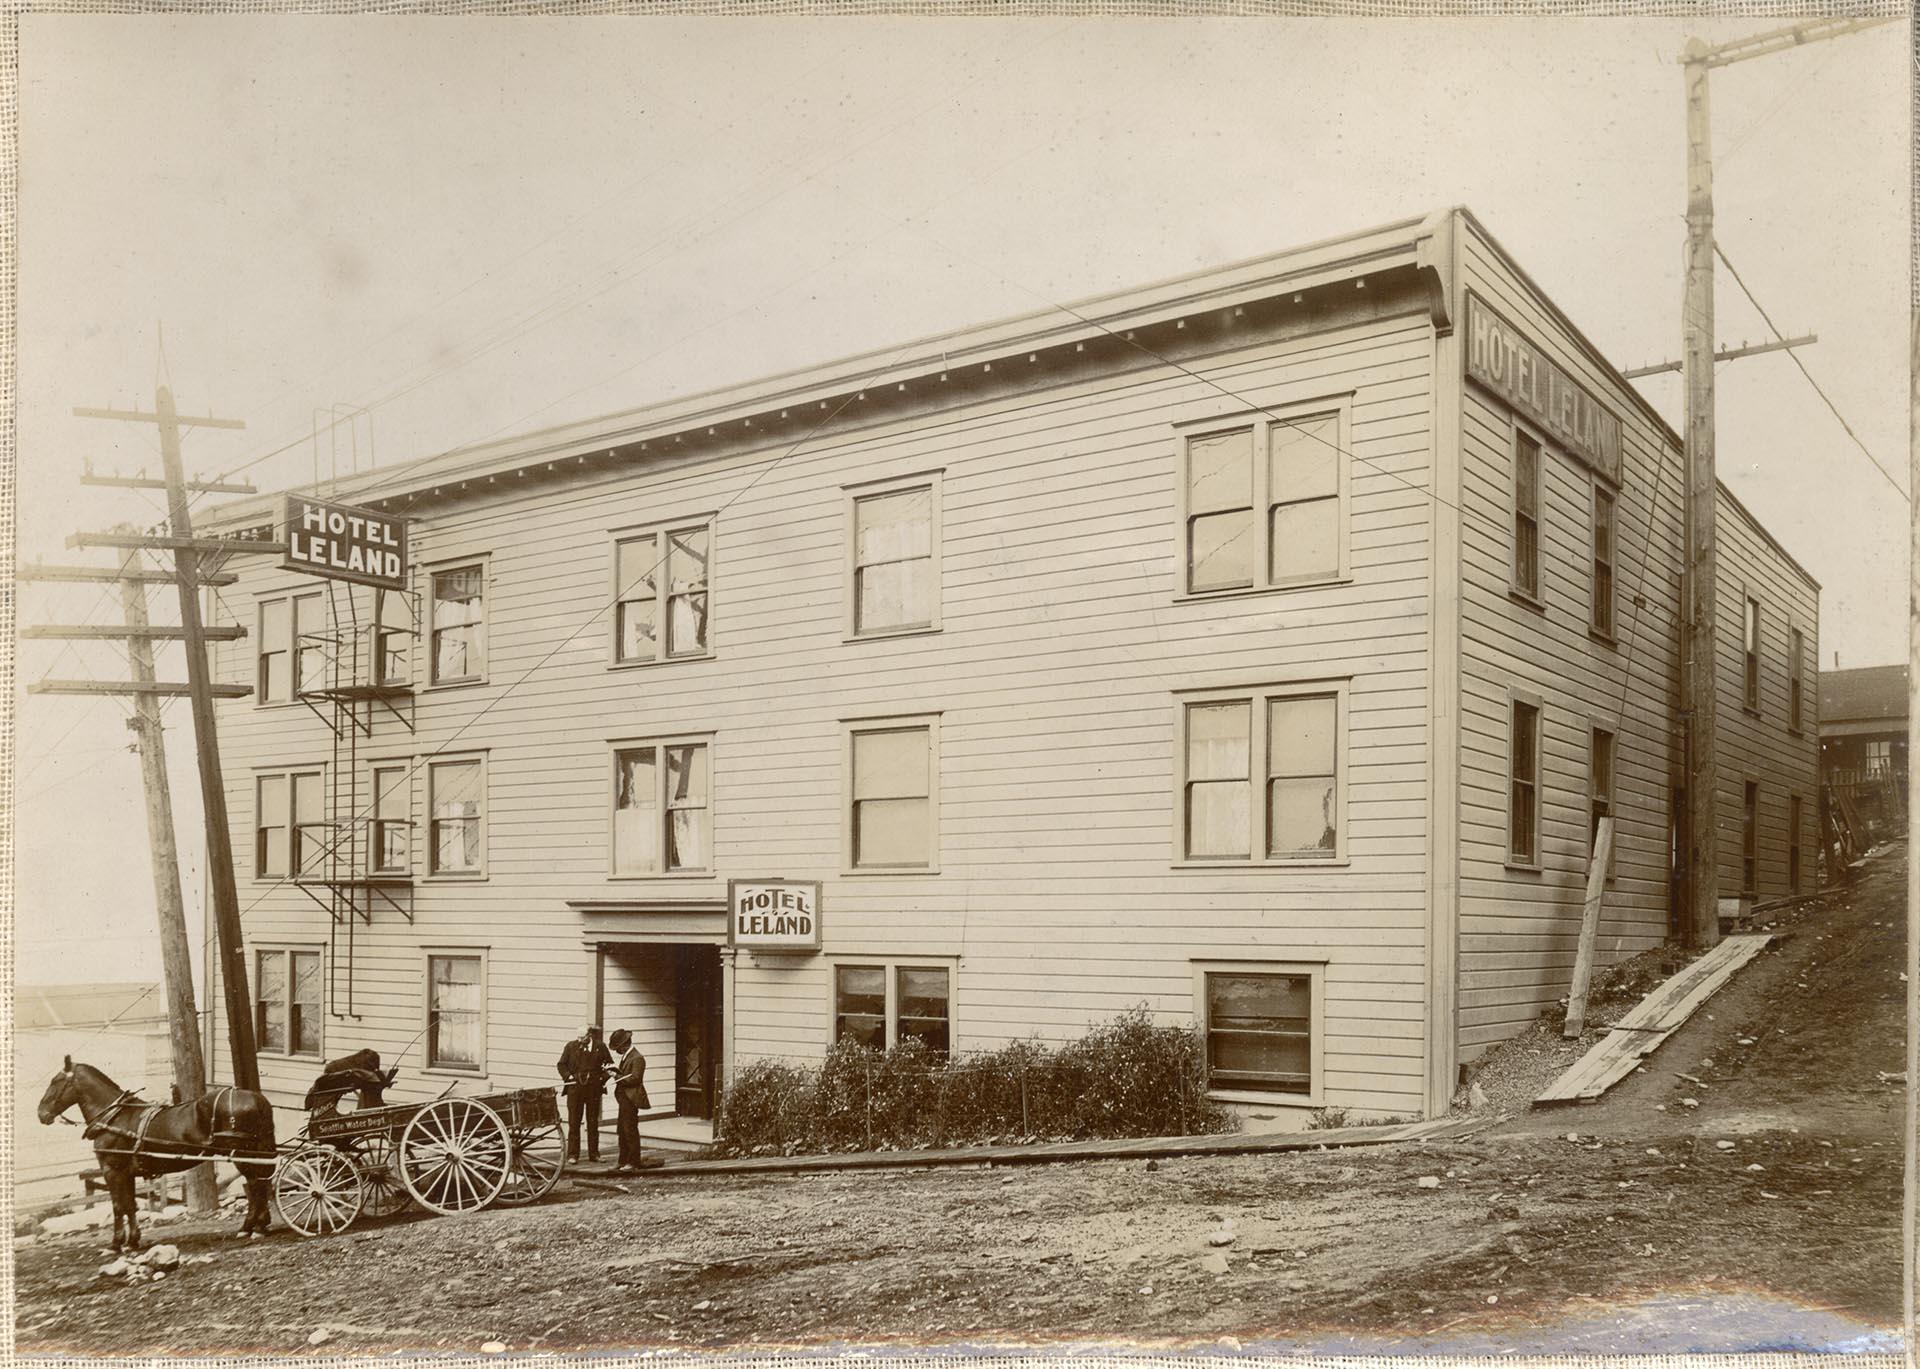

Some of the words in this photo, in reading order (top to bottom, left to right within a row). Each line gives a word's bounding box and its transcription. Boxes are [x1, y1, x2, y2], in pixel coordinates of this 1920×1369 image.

[1474, 310, 1543, 414] HOTEL
[303, 504, 398, 546] HOTEL
[291, 532, 400, 578] LELAND
[740, 888, 810, 915] HOTEL
[738, 916, 812, 935] LELAND
[319, 1121, 345, 1134] Seattle
[345, 1120, 367, 1129] Water
